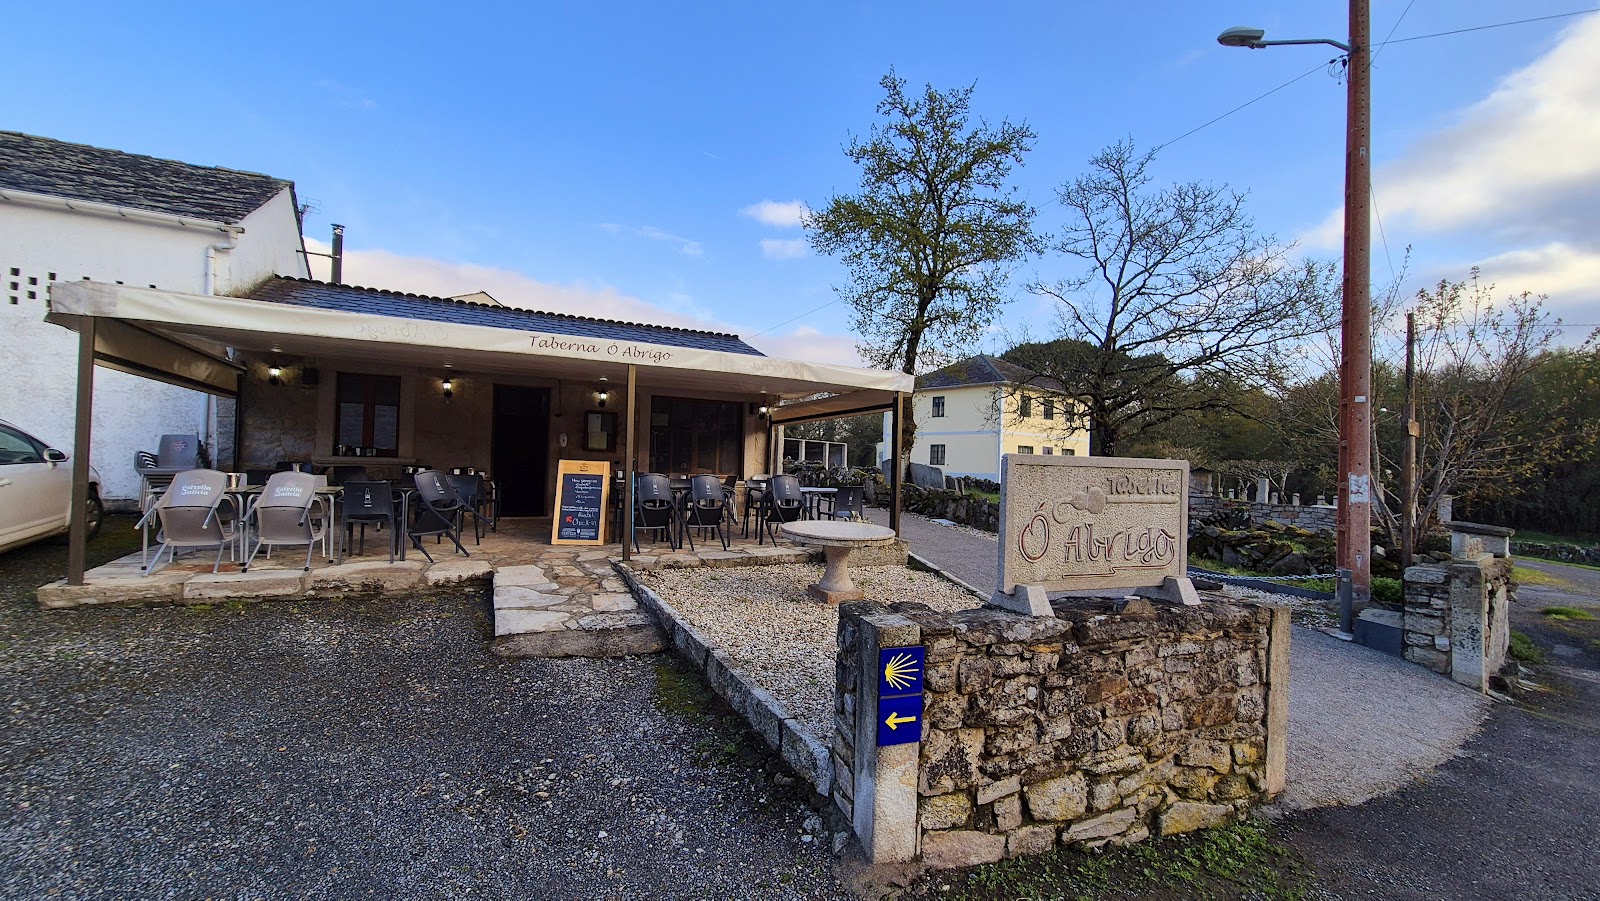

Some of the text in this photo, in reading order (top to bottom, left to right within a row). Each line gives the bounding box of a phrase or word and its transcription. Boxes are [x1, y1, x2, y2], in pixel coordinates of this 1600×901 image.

[529, 335, 673, 363] Taberna Ó Abrigo
[181, 484, 211, 492] Estrella
[1018, 502, 1176, 567] Ó Abrigo
